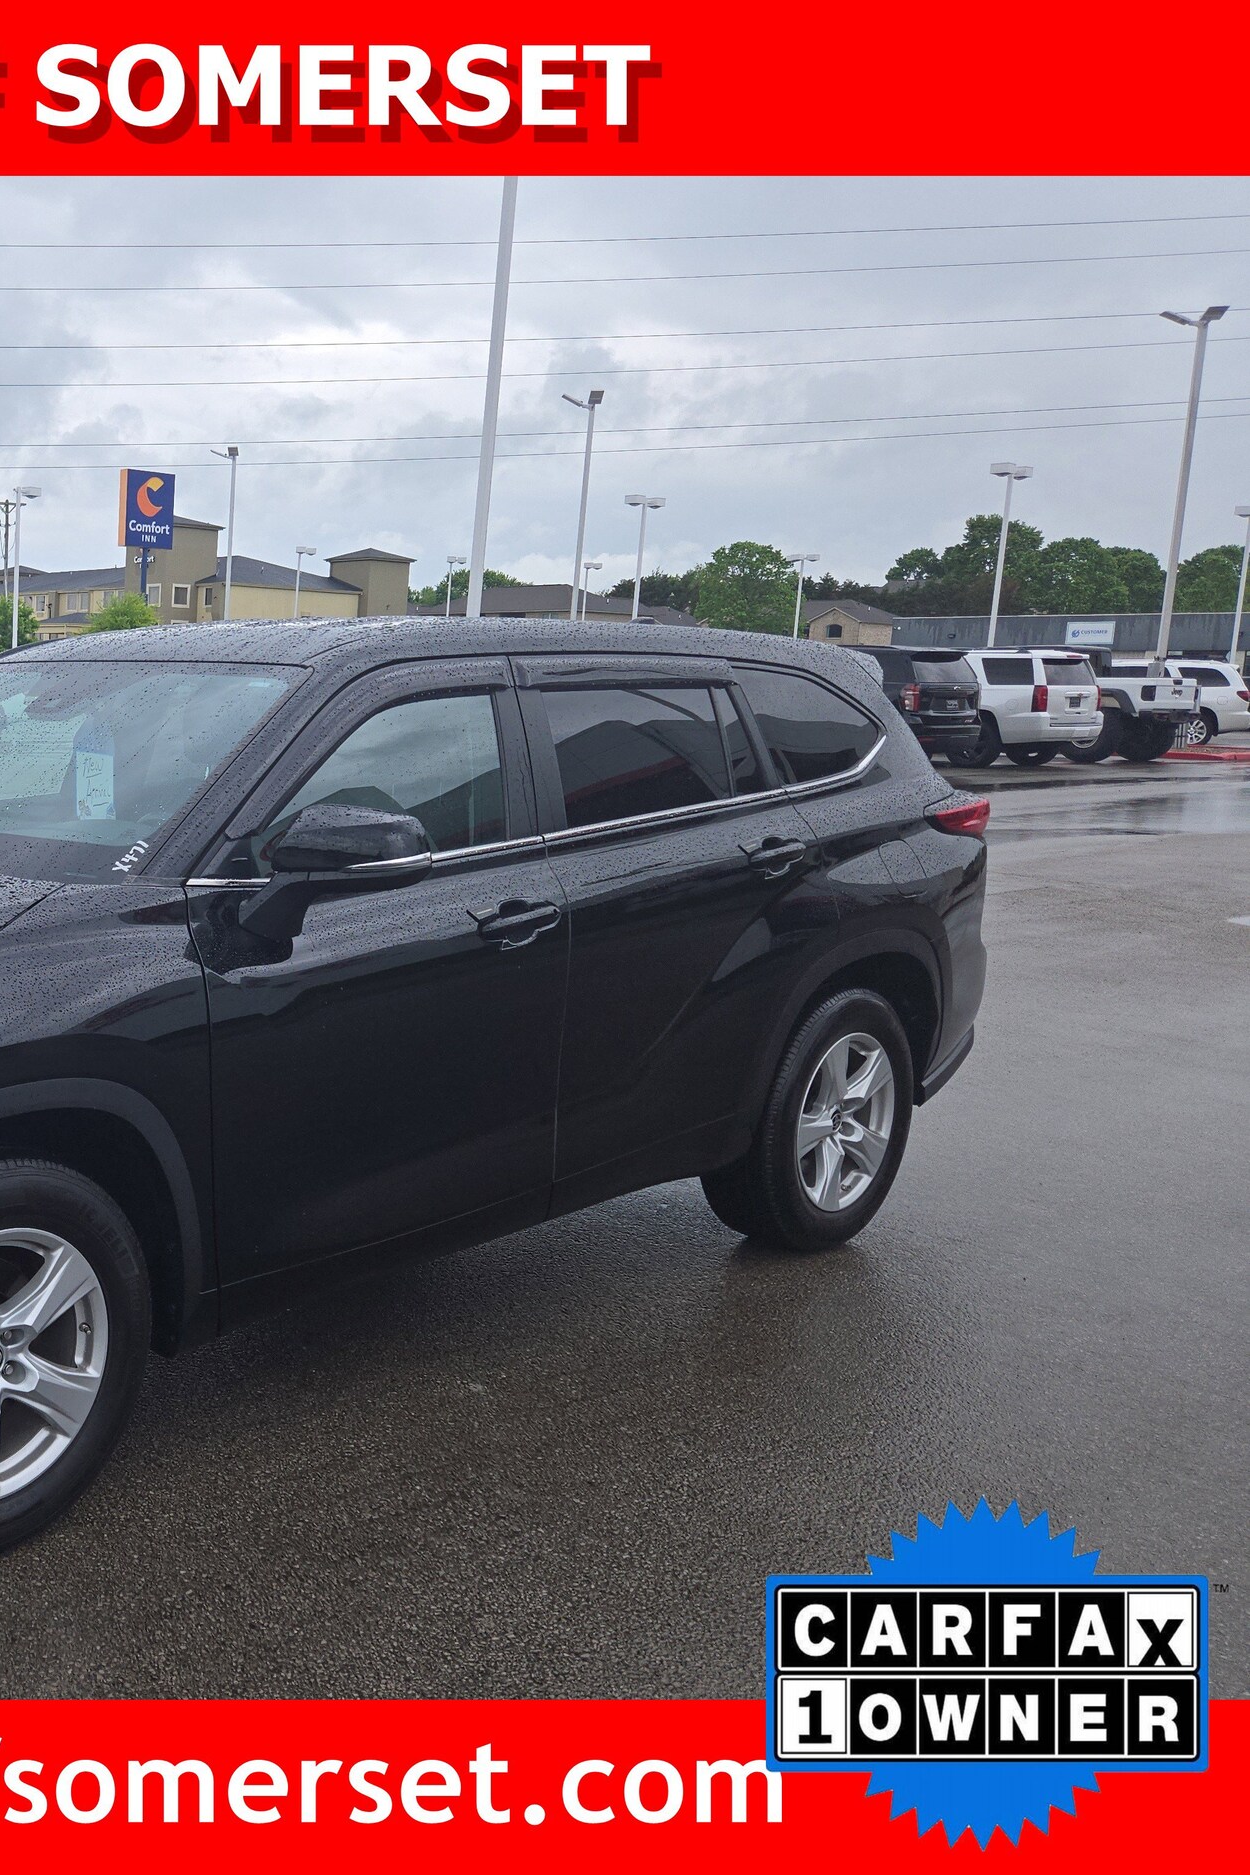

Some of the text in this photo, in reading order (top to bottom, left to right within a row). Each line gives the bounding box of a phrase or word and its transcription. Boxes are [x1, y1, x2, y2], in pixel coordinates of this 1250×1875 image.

[129, 519, 170, 535] Comfort
[141, 534, 157, 543] INN
[1171, 687, 1183, 697] Jeep
[112, 840, 149, 873] X471
